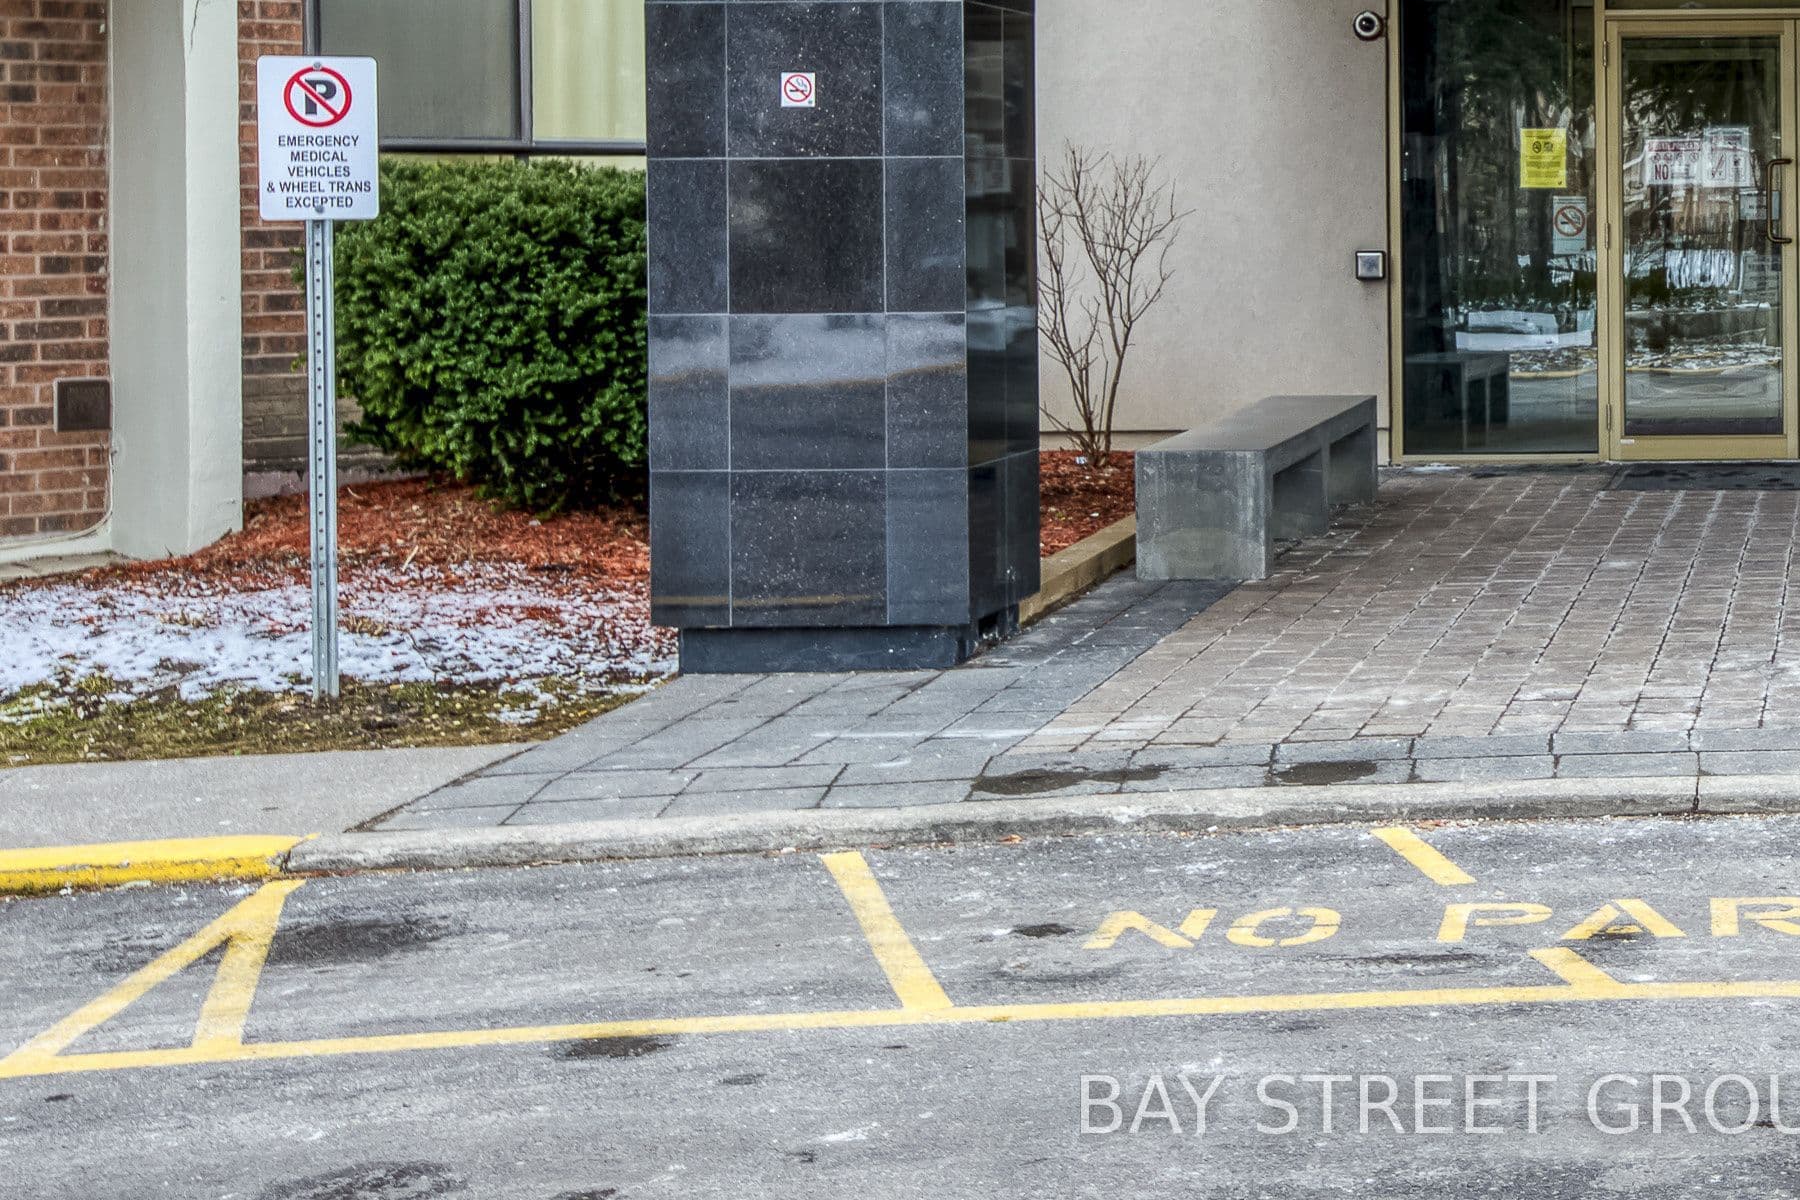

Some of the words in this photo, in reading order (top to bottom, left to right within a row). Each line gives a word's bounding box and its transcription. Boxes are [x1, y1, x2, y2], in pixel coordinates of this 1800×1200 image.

[278, 134, 359, 147] EMERGENCY
[290, 150, 348, 162] MEDICAL
[287, 165, 351, 178] VEHICLES
[266, 181, 275, 193] &
[279, 181, 325, 193] WHEEL
[328, 181, 371, 193] TRANS
[285, 196, 353, 209] EXCEPTED
[1082, 906, 1341, 950] NO
